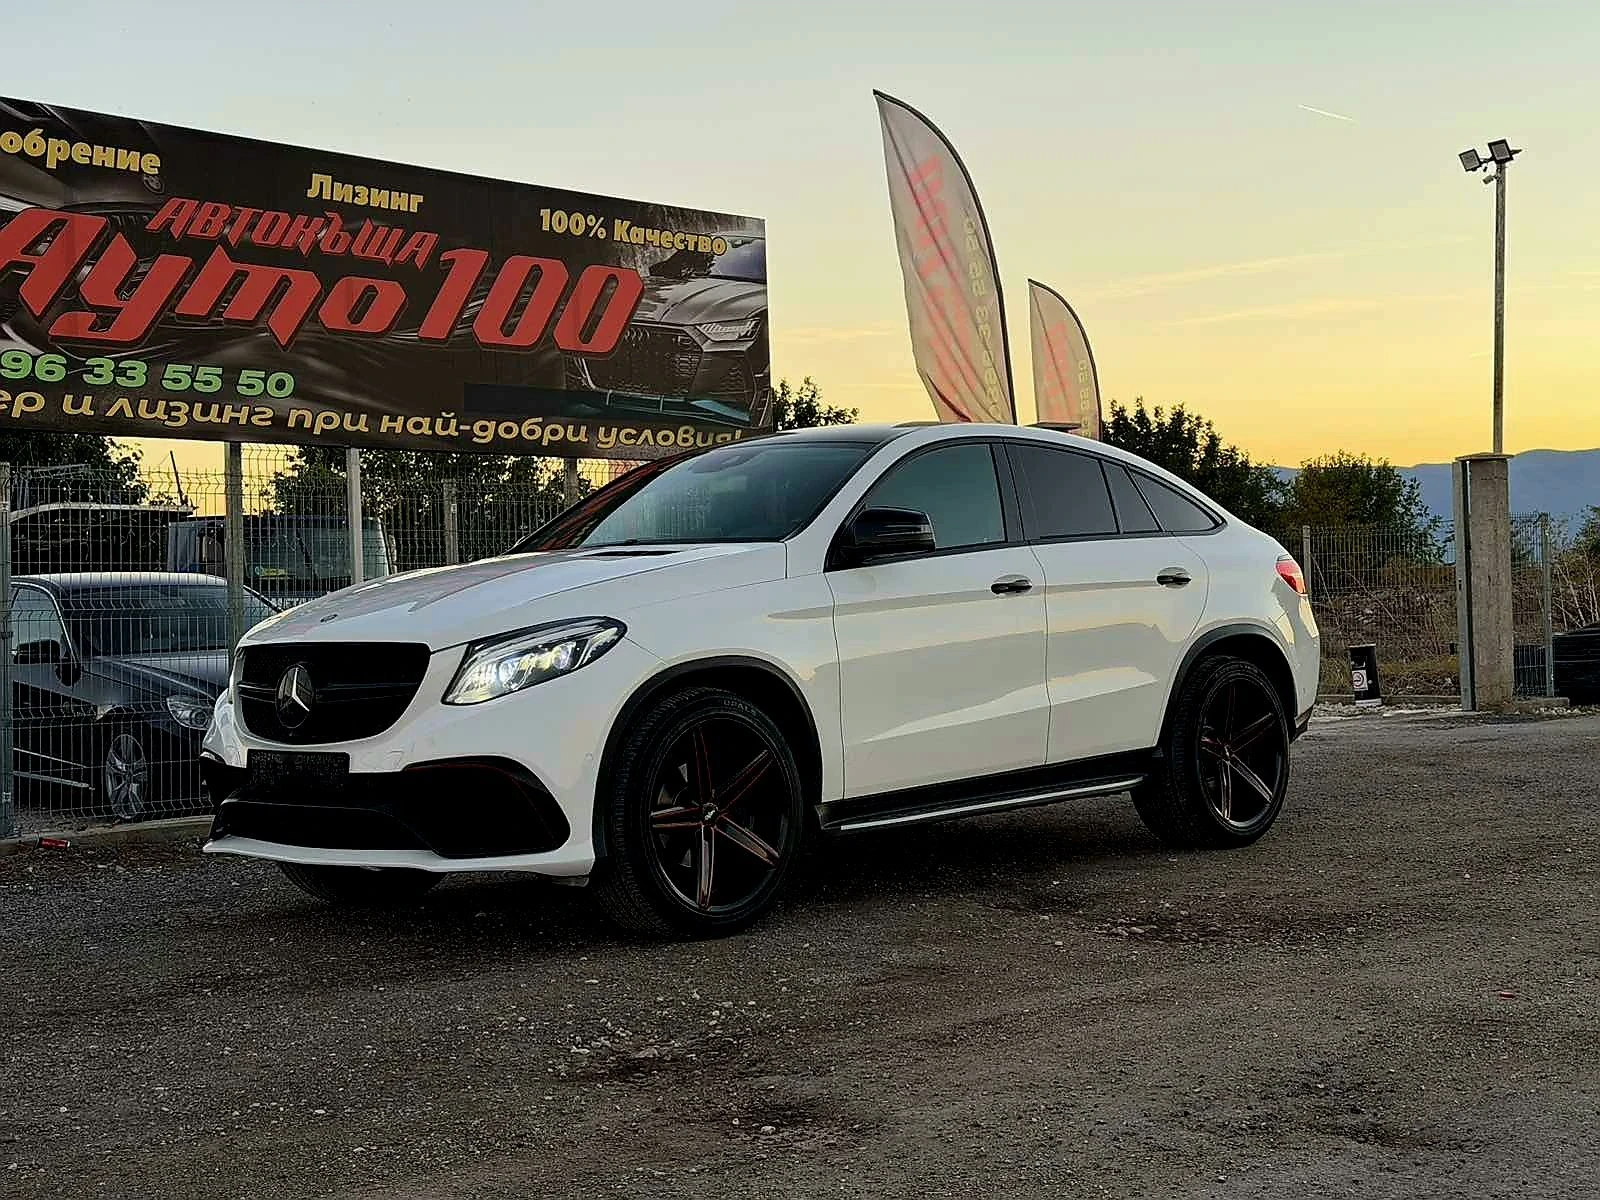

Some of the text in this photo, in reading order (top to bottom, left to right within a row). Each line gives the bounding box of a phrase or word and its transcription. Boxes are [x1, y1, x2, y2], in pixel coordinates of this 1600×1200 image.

[0, 128, 161, 175] обрение
[306, 173, 424, 213] Лизинг
[539, 208, 727, 256] 100% Качество
[0, 350, 296, 397] 96 33 55 50
[62, 393, 95, 417] и
[287, 408, 369, 435] при
[380, 412, 589, 446] най-добри
